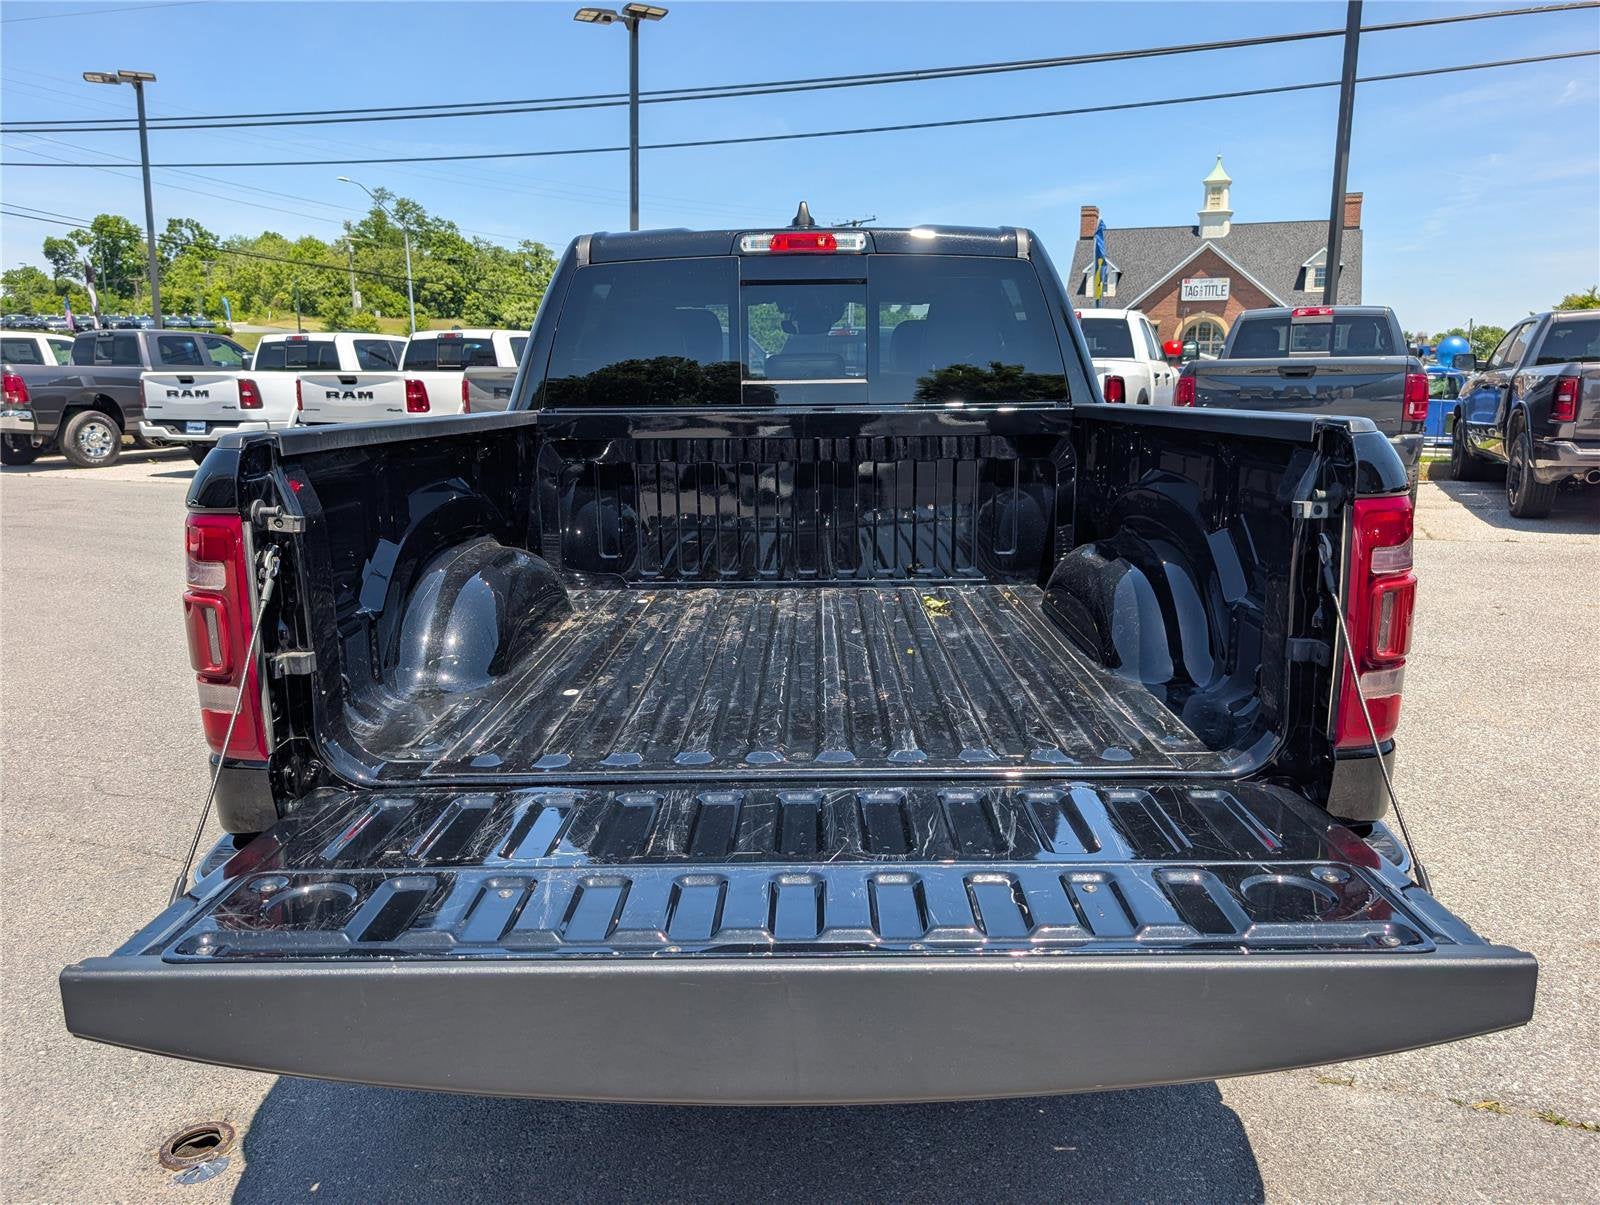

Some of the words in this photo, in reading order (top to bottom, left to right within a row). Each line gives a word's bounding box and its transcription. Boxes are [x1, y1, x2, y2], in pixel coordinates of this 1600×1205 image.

[1184, 285, 1199, 297] TAG
[1204, 284, 1228, 297] TITLE
[166, 389, 210, 398] RAM
[325, 391, 374, 399] RAM
[1239, 385, 1354, 400] RAM
